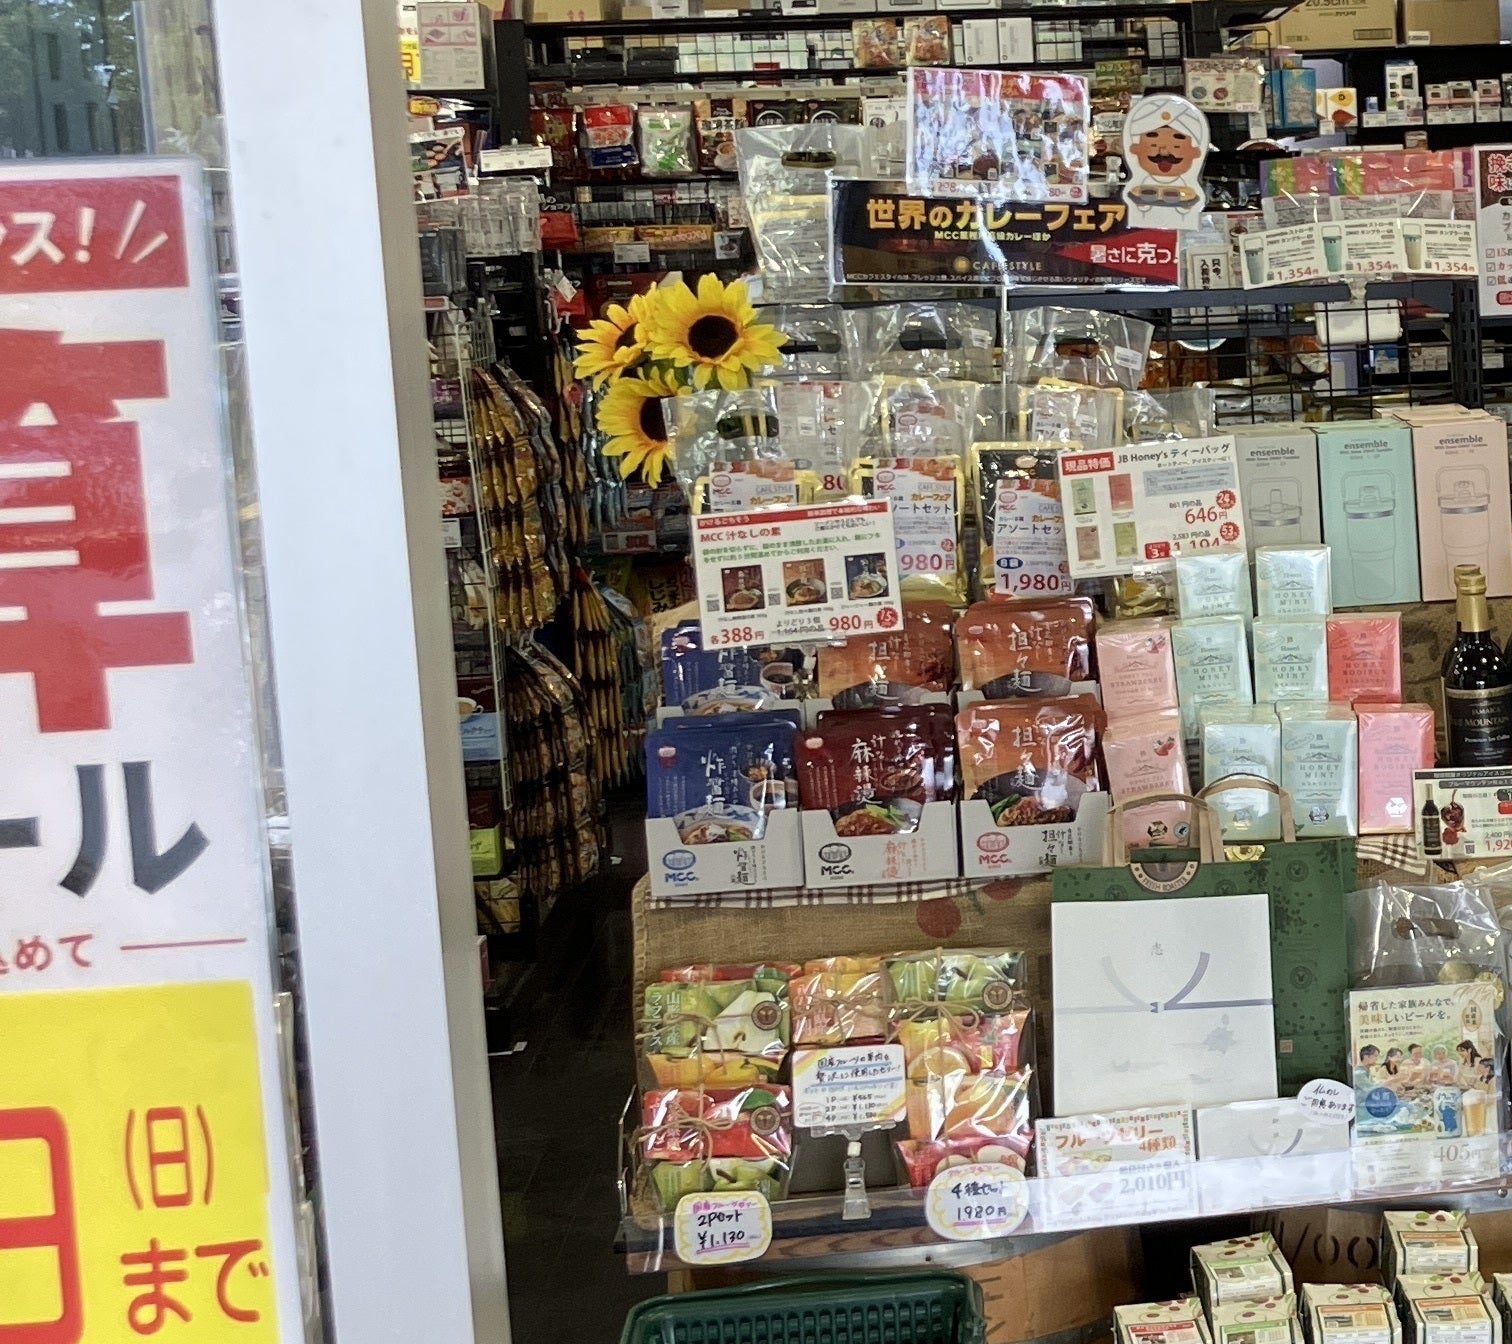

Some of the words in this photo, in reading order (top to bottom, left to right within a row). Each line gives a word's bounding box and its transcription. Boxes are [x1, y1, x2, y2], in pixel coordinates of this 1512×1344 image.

[866, 199, 1126, 233] 世界のカレーフェア
[1344, 439, 1389, 451] ensemble
[1439, 434, 1484, 446] ensemble
[1250, 448, 1295, 458] ensemble
[1064, 458, 1112, 471] 現品特価
[1185, 507, 1228, 524] 646円
[1001, 573, 1072, 592] 1,980円
[122, 1105, 215, 1212] (日)
[118, 1238, 271, 1337] まで
